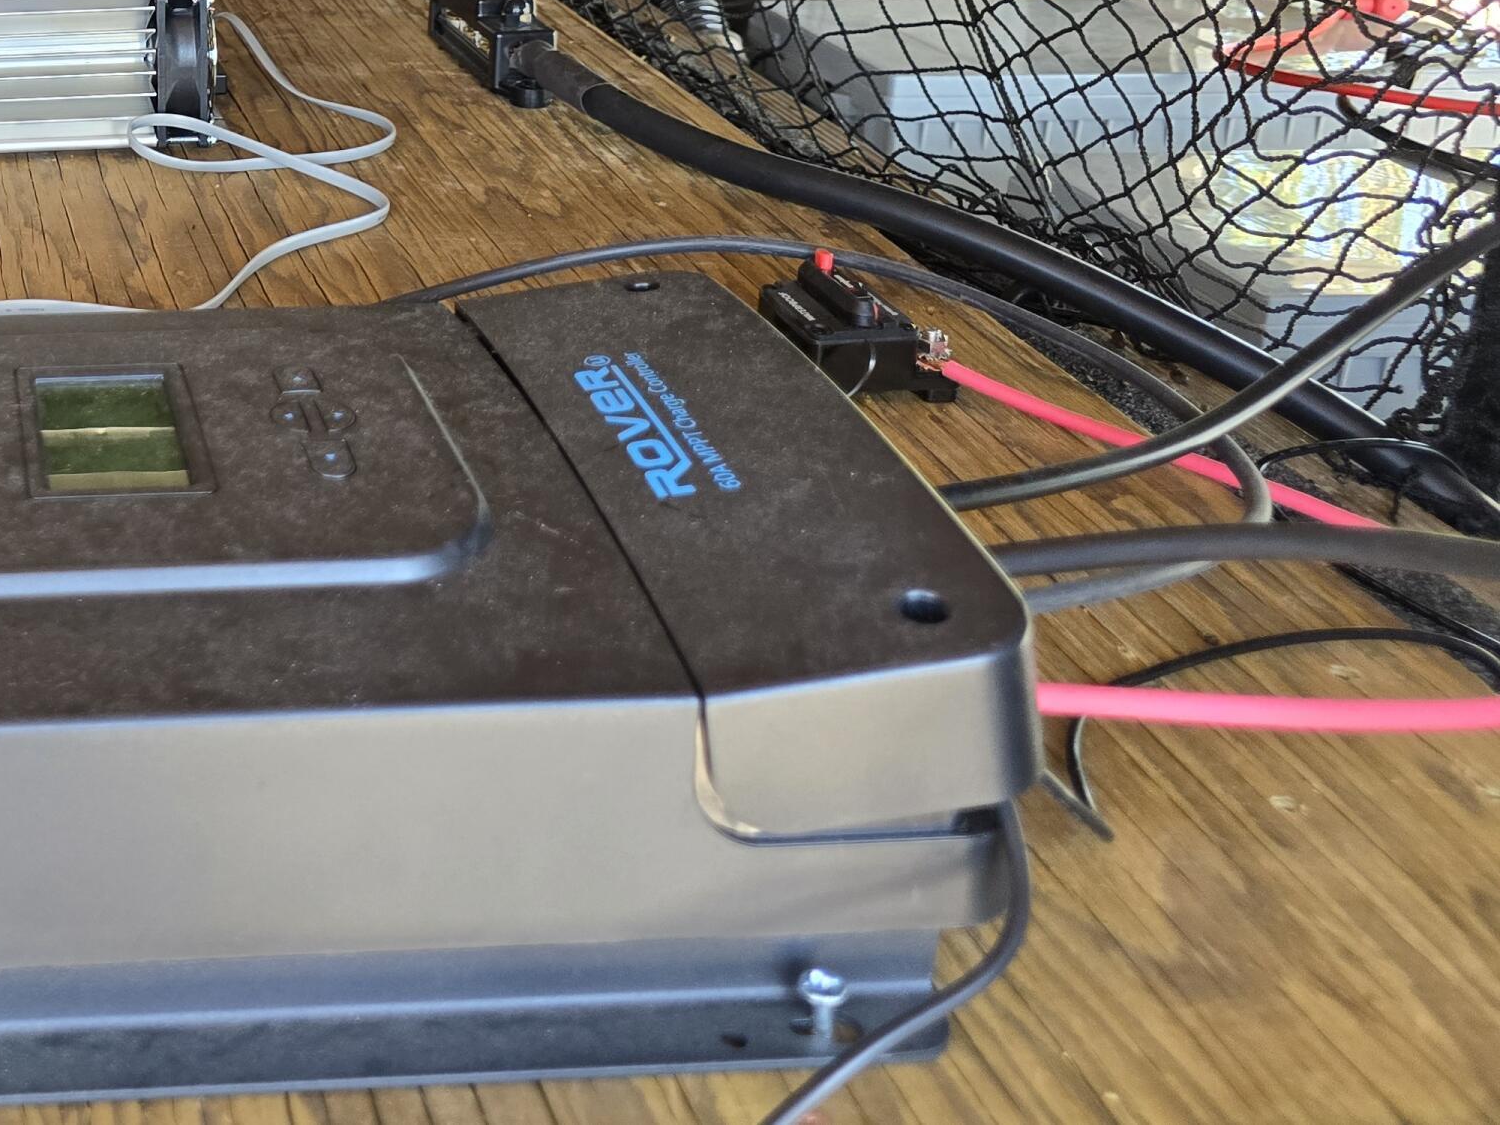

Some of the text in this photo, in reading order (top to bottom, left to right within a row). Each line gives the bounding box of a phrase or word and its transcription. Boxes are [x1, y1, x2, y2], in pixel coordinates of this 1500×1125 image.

[624, 351, 741, 490] 60A MPPT Charge Controller
